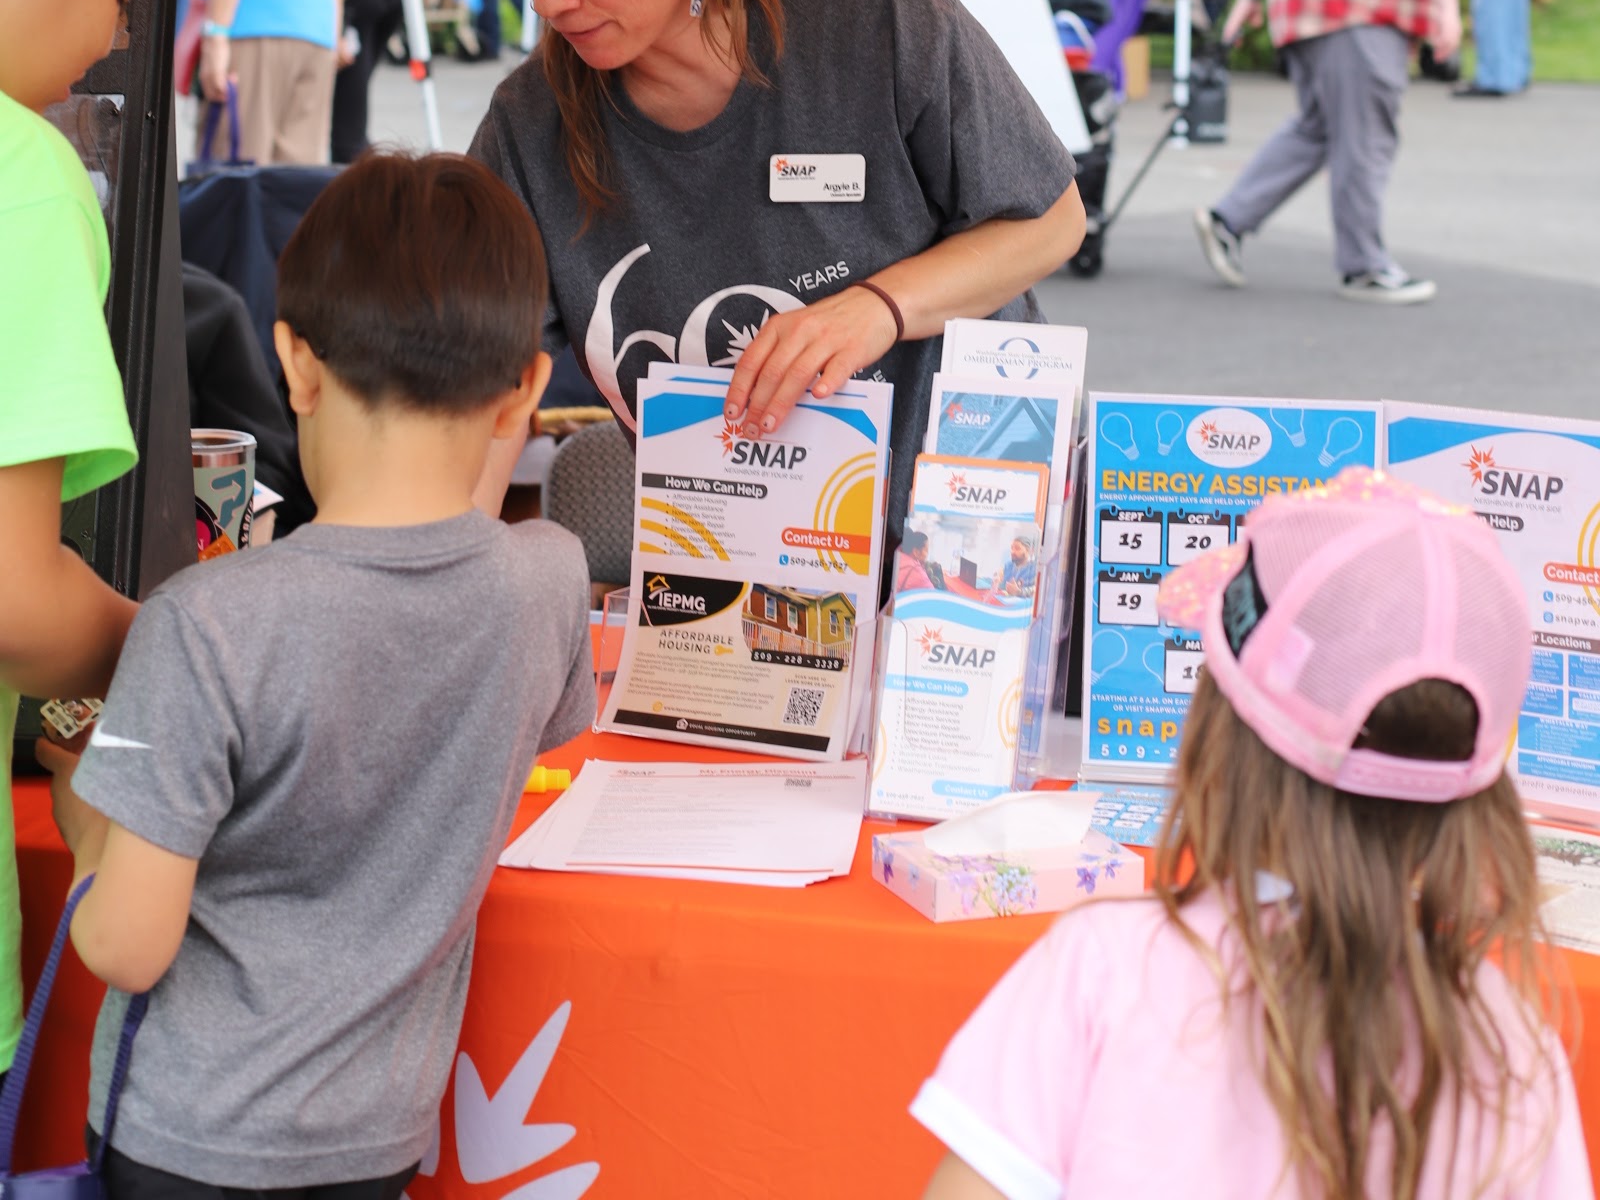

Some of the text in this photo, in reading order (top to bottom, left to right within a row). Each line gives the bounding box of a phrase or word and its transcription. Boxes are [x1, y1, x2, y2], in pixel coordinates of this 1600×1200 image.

[781, 166, 817, 176] SNAP
[788, 260, 850, 294] YEARS
[963, 354, 1072, 370] OMBUDSMAN PROGRAM
[954, 412, 991, 426] SNAP
[1207, 434, 1261, 450] SNAP
[730, 441, 807, 470] SNAP
[665, 475, 764, 499] How We Can Help
[1102, 469, 1204, 494] ENERGY
[1480, 470, 1564, 501] SNAP
[955, 486, 1007, 504] SNAP
[1099, 492, 1127, 501] ENERGY
[1128, 494, 1179, 503] APPOINTMENT
[1180, 496, 1198, 504] DAYS
[1214, 498, 1233, 506] HELD
[1118, 511, 1145, 521] SEPT
[1187, 514, 1210, 524] OCT
[1489, 514, 1520, 532] Help
[784, 530, 850, 549] Contact Us
[1119, 533, 1142, 549] 15
[1185, 535, 1211, 549] 20
[1119, 572, 1139, 583] JAN
[1546, 565, 1600, 585] Contact
[658, 590, 706, 611] IEPMG
[1117, 593, 1141, 610] 19
[660, 628, 734, 645] AFFORDABLE
[1540, 633, 1592, 650] Locations
[658, 639, 711, 654] HOUSING
[1185, 640, 1205, 651] MA
[928, 644, 996, 668] SNAP
[912, 680, 925, 688] We
[927, 682, 942, 690] Can
[944, 683, 963, 695] Help
[1091, 694, 1128, 703] STARTING
[1145, 697, 1161, 705] A.M.
[1125, 705, 1143, 713] VISIT
[1097, 717, 1178, 743] snap
[944, 784, 977, 796] Contact
